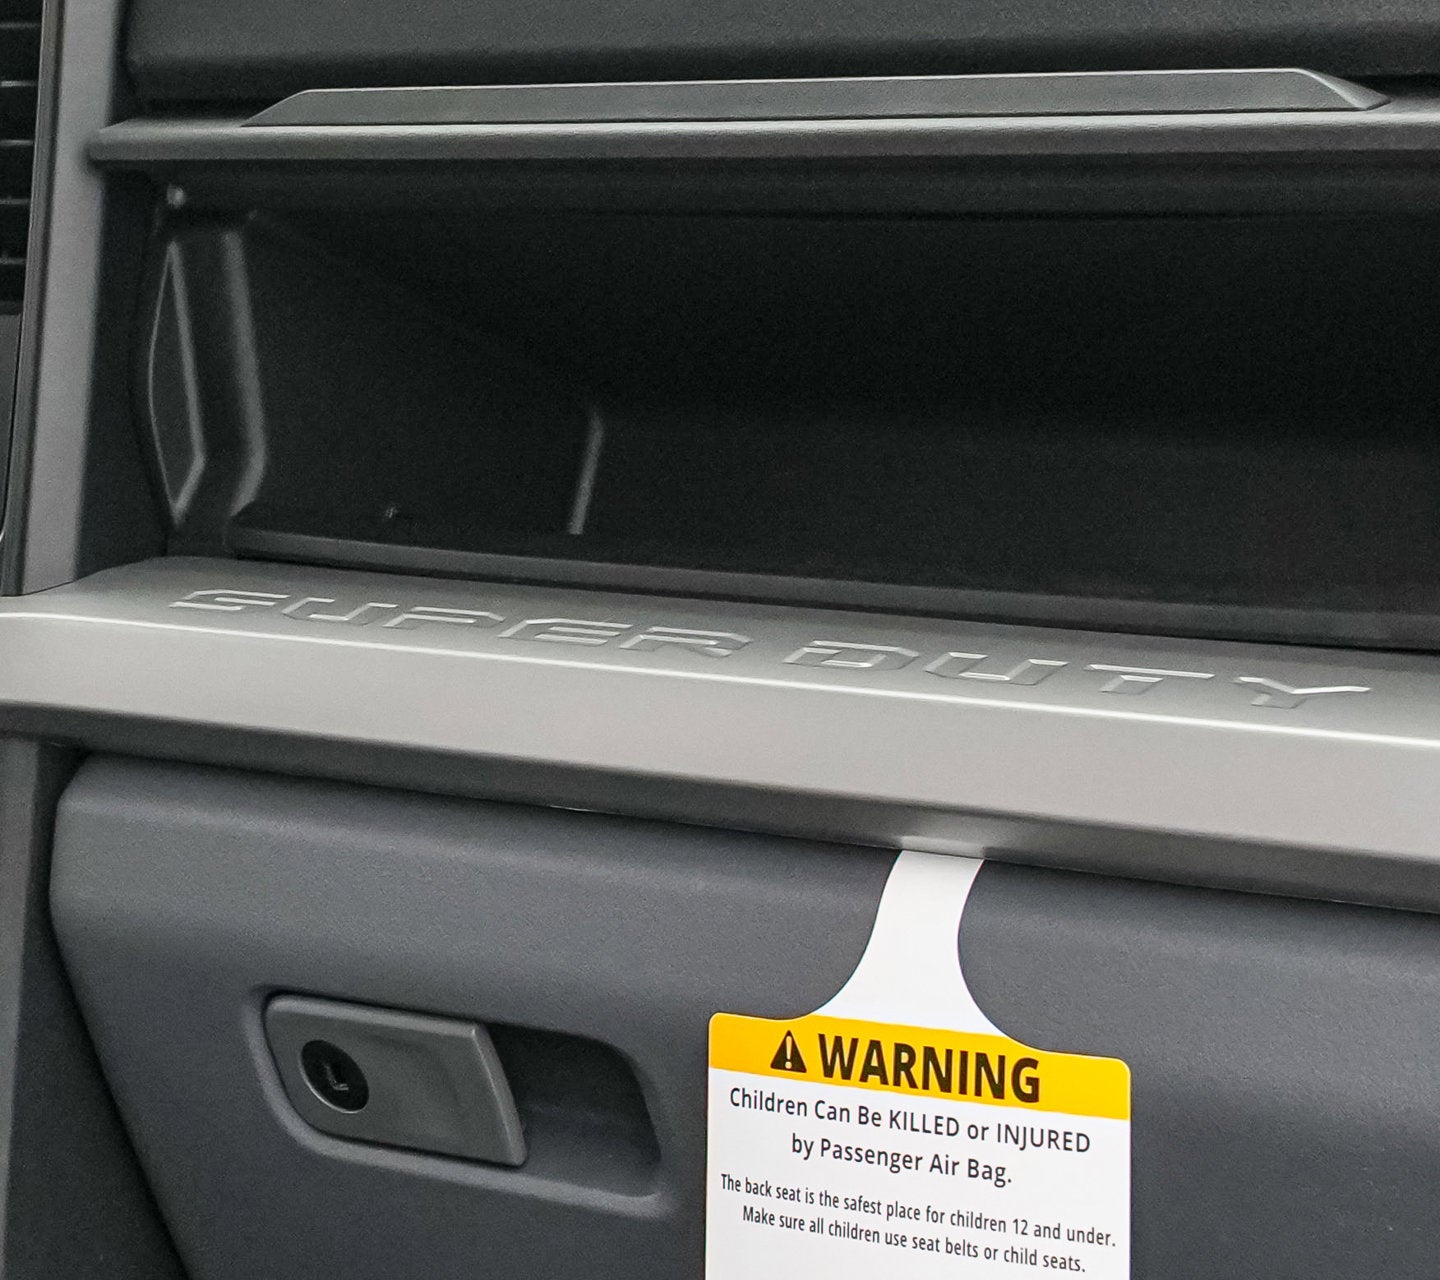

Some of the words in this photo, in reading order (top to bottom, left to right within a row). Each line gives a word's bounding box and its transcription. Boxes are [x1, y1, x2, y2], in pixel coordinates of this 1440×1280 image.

[168, 588, 754, 658] SUPER
[783, 639, 1372, 709] DUTY
[817, 1033, 1040, 1103] WARNING
[730, 1087, 807, 1117] Children
[815, 1100, 850, 1123] Can
[858, 1106, 882, 1128] Be
[889, 1109, 960, 1137] KILLED
[967, 1124, 989, 1141] or
[997, 1123, 1090, 1153] INJURED
[792, 1132, 814, 1160] by
[821, 1138, 923, 1174] Passenger
[929, 1154, 960, 1176] Air
[967, 1158, 1012, 1188] Bag.
[721, 1173, 741, 1193] The
[745, 1176, 772, 1198] back
[776, 1186, 801, 1203] seat
[805, 1187, 815, 1204] is
[819, 1190, 839, 1209] the
[844, 1195, 882, 1216] safest
[886, 1201, 921, 1222] place
[926, 1205, 945, 1224] for
[950, 1209, 1007, 1233] children
[1012, 1219, 1028, 1236] 12
[1034, 1223, 1061, 1240] and
[1066, 1227, 1116, 1247] under.
[742, 1205, 775, 1226] Make
[779, 1214, 805, 1231] sure
[809, 1217, 824, 1235] all
[828, 1220, 880, 1244] children
[885, 1232, 907, 1248] use
[912, 1235, 940, 1253] seat
[945, 1237, 979, 1259] belts
[984, 1246, 998, 1261] or
[1003, 1245, 1038, 1266] child
[1043, 1254, 1086, 1273] seats.
